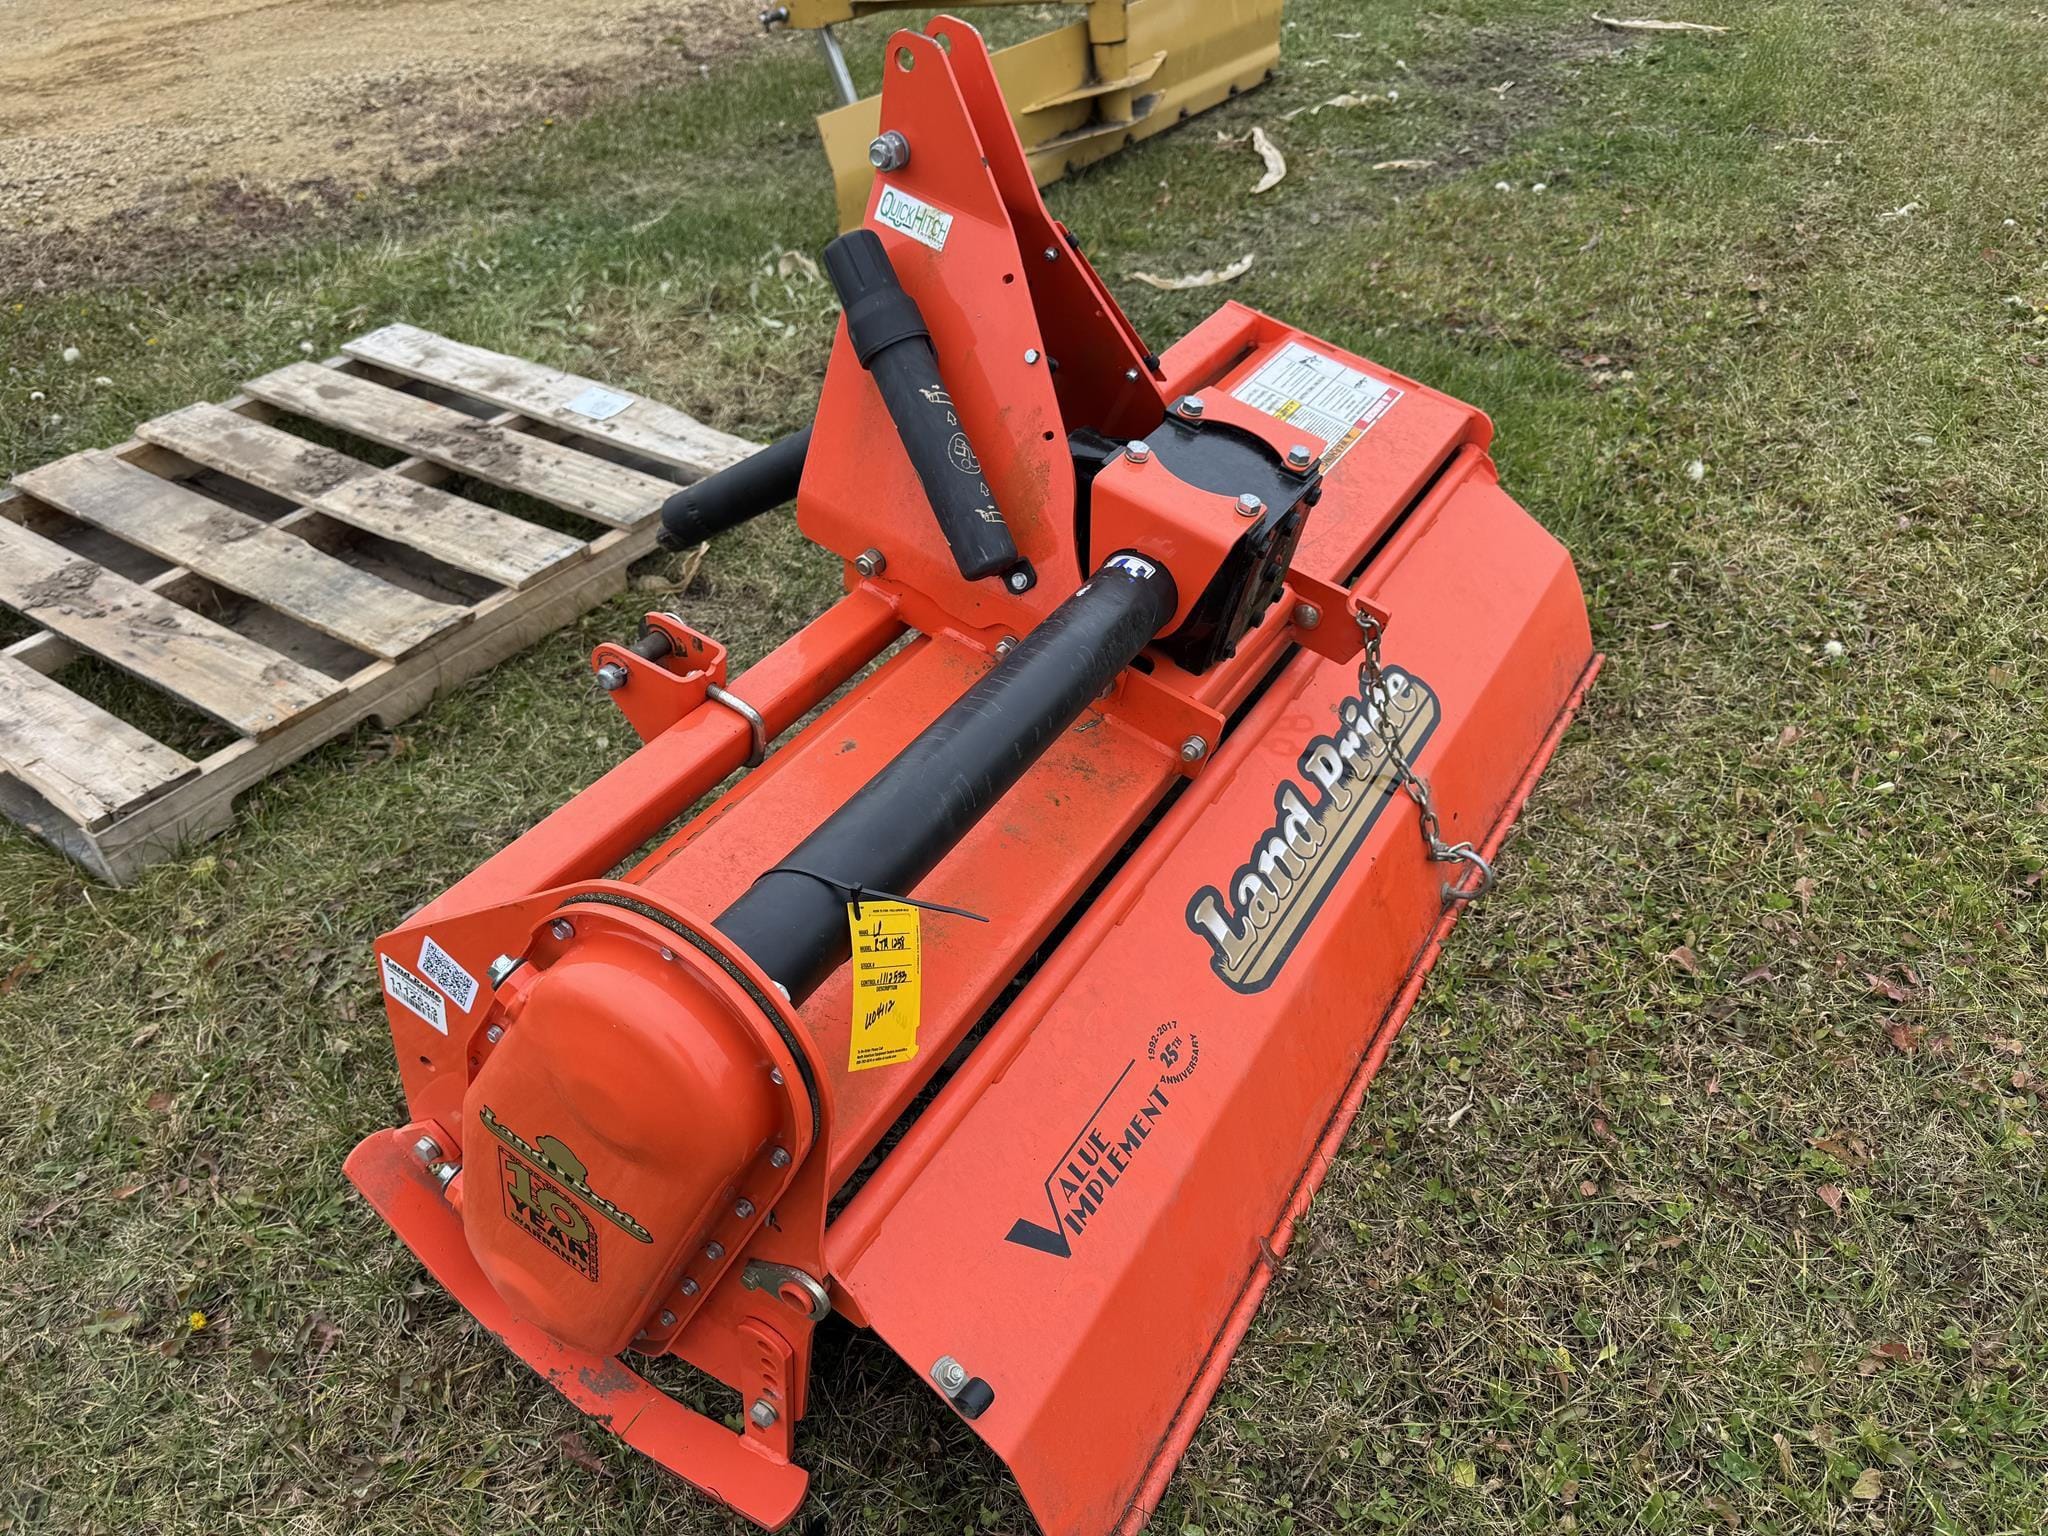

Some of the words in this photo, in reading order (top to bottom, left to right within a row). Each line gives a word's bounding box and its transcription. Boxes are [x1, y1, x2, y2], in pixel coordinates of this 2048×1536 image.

[1194, 788, 1327, 971] Land
[1160, 1033, 1200, 1084] ANNIVERSARY
[480, 1104, 552, 1173] Land
[555, 1166, 652, 1241] Pride
[505, 1159, 591, 1243] 10
[1063, 1084, 1170, 1236] IMPLEMENT
[510, 1190, 589, 1262] YEAR
[510, 1211, 588, 1274] WARRANTY
